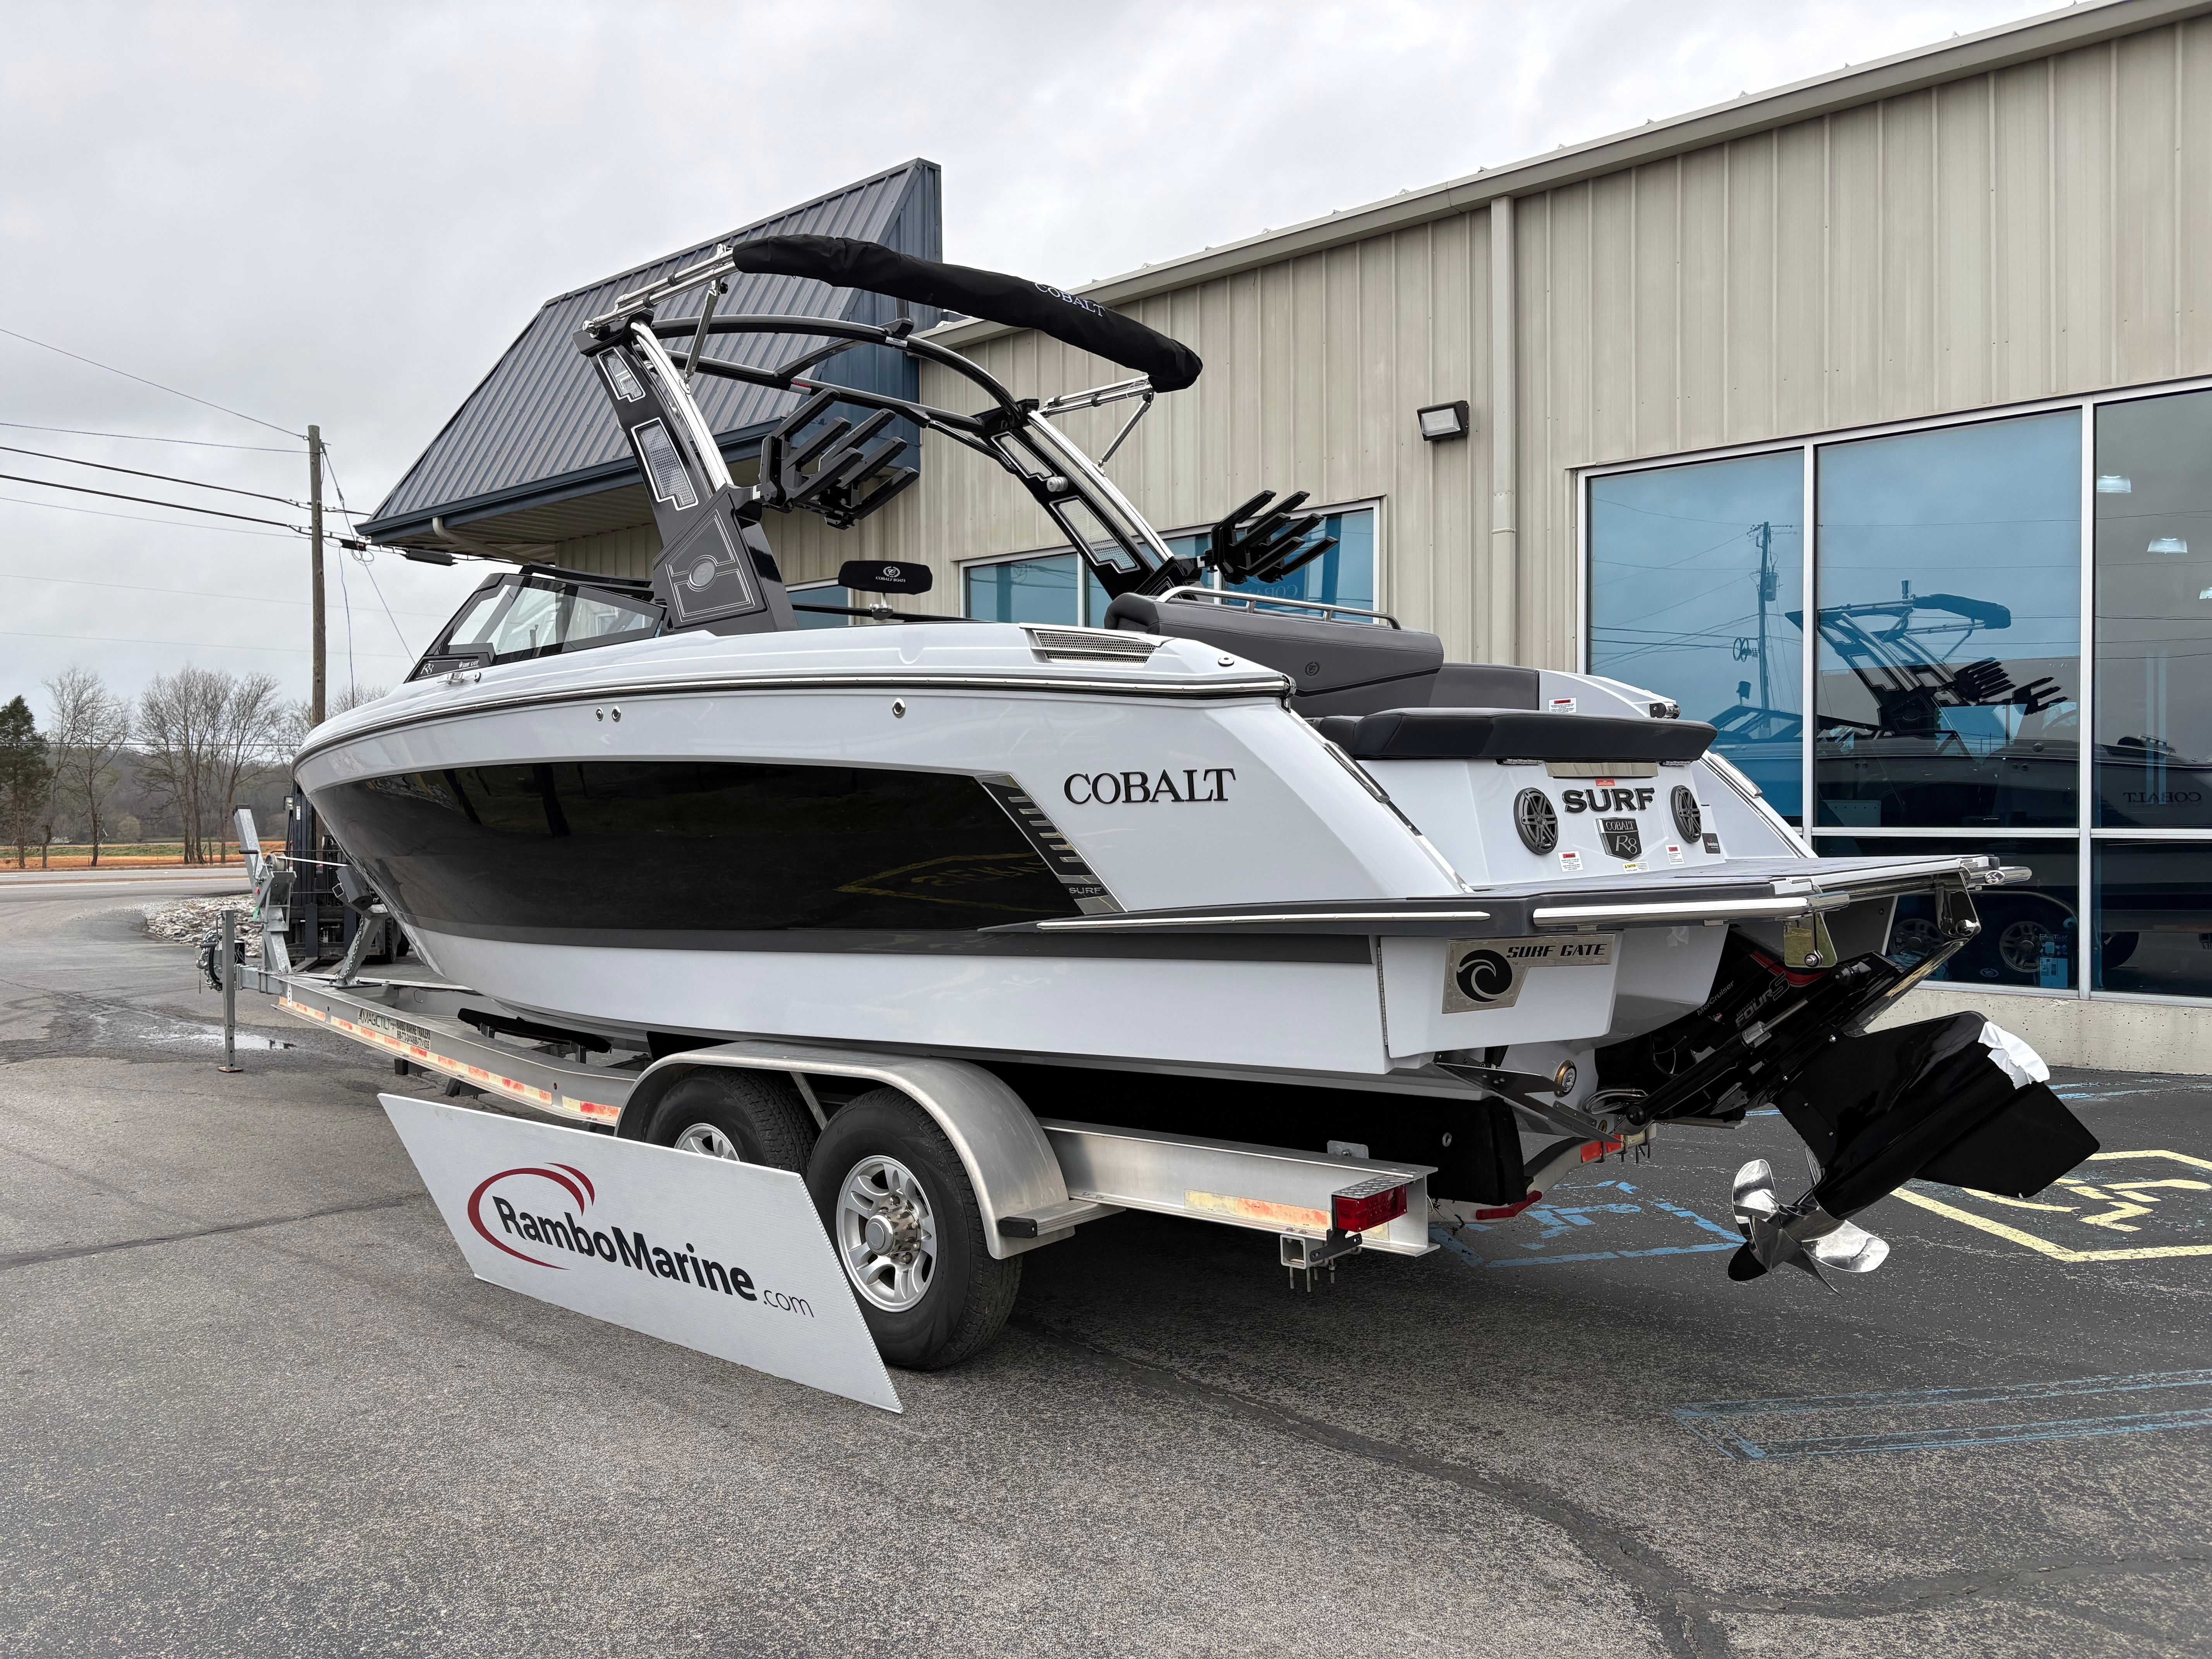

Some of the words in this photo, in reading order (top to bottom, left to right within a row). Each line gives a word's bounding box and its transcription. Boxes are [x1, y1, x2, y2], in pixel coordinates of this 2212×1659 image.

[1034, 282, 1106, 317] COBALT
[420, 663, 434, 675] R8
[1064, 768, 1236, 805] COBALT
[1562, 787, 1655, 813] SURF
[1606, 821, 1634, 831] COBALT
[1615, 835, 1637, 854] R8
[1068, 887, 1102, 895] SURF
[1506, 945, 1556, 958] SURF
[1560, 943, 1607, 956] GATE
[1697, 980, 1735, 1016] MerCruiser
